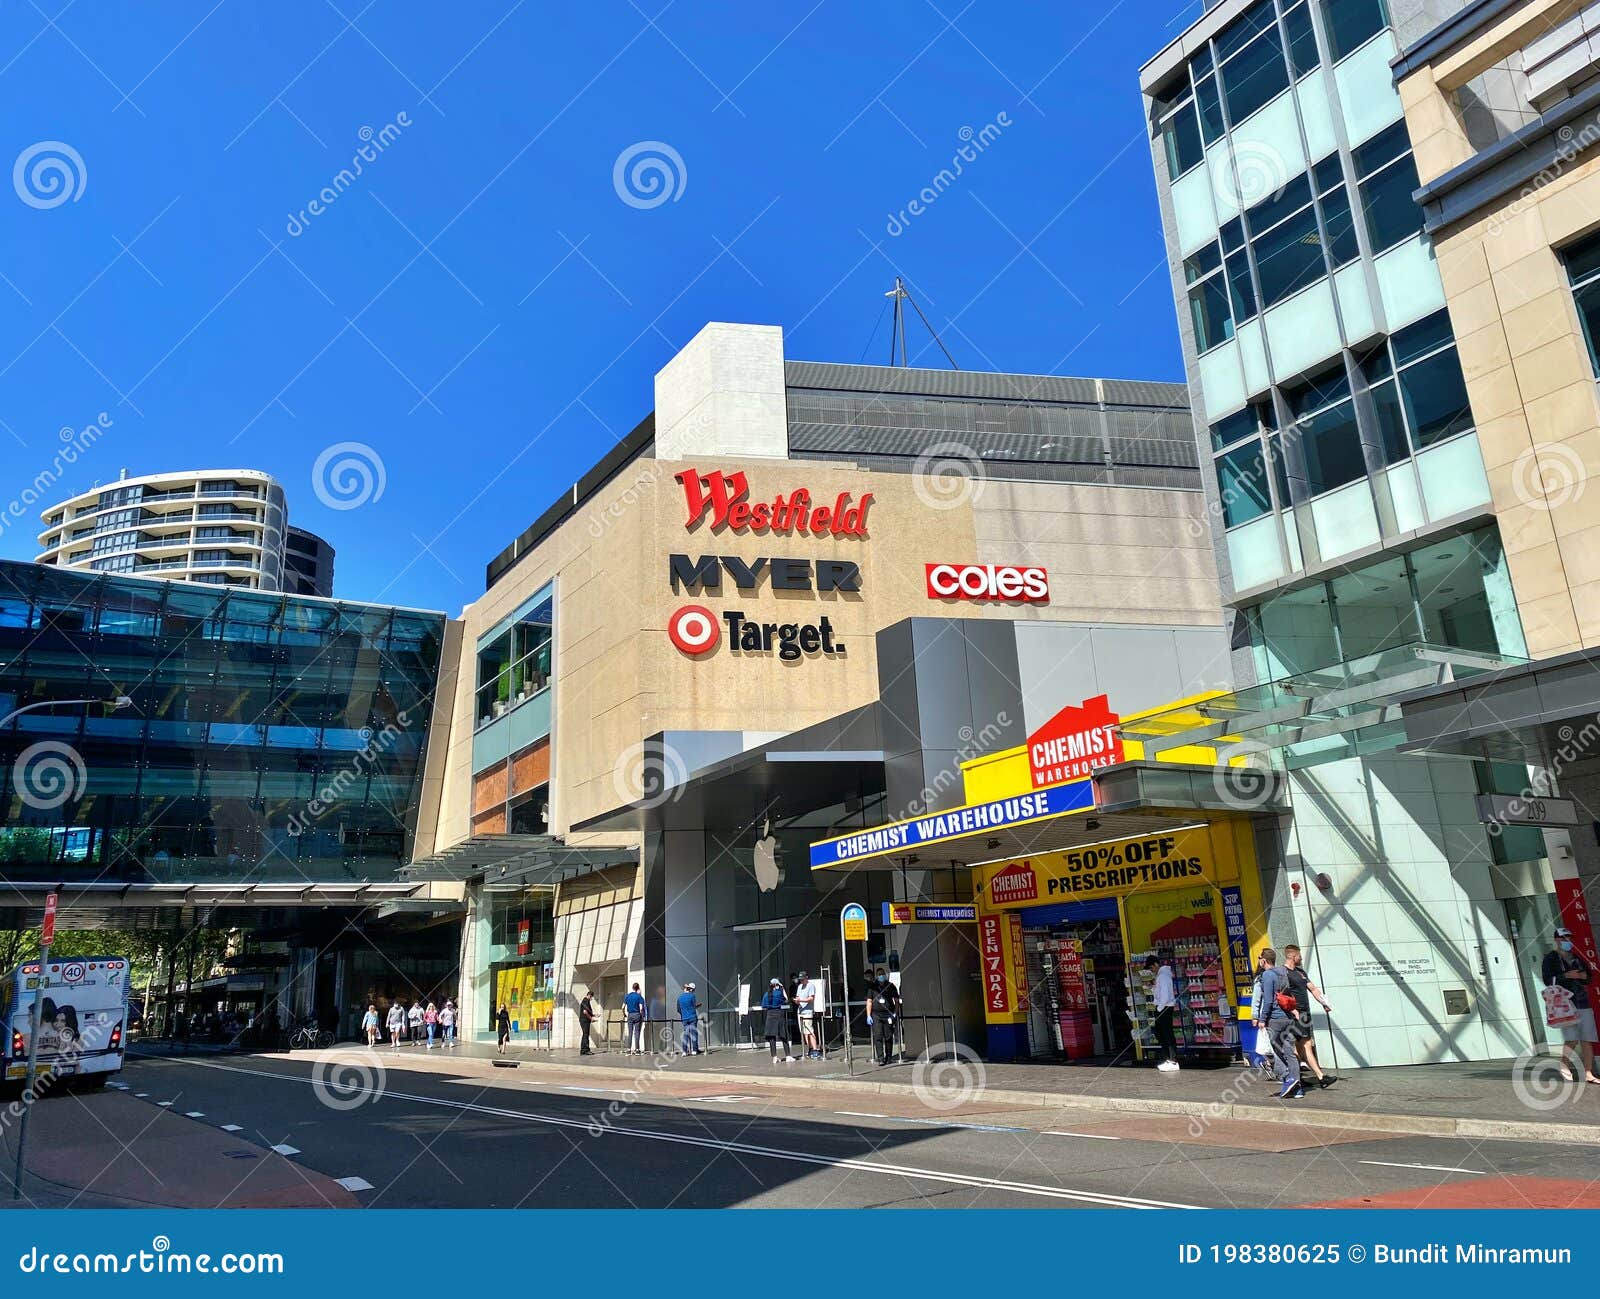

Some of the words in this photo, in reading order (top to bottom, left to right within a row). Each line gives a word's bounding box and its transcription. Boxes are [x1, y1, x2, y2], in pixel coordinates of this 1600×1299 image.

[674, 467, 874, 536] Westfield
[669, 553, 861, 593] MYER
[929, 563, 1049, 598] coles
[722, 610, 846, 661] Target.
[1031, 724, 1116, 769] CHEMIST
[1035, 753, 1117, 785] WAREHOUSE
[836, 824, 910, 859] CHEMIST
[917, 792, 1049, 840] WAREHOUSE
[1067, 846, 1123, 873] 50%
[1124, 837, 1175, 864] OFF
[992, 871, 1033, 893] CHEMIST
[1047, 857, 1202, 895] PRESCRIPTIONS
[994, 889, 1036, 902] WAREHOUSE
[1224, 893, 1239, 905] STOP
[916, 908, 940, 919] CHEMIST
[942, 908, 975, 918] WAREHOUSE
[1229, 915, 1240, 925] TOO
[984, 919, 999, 953] OPEN
[65, 967, 82, 978] 40
[986, 956, 1000, 971] 7
[1057, 952, 1077, 961] EALTH
[989, 974, 1004, 1009] DAYS
